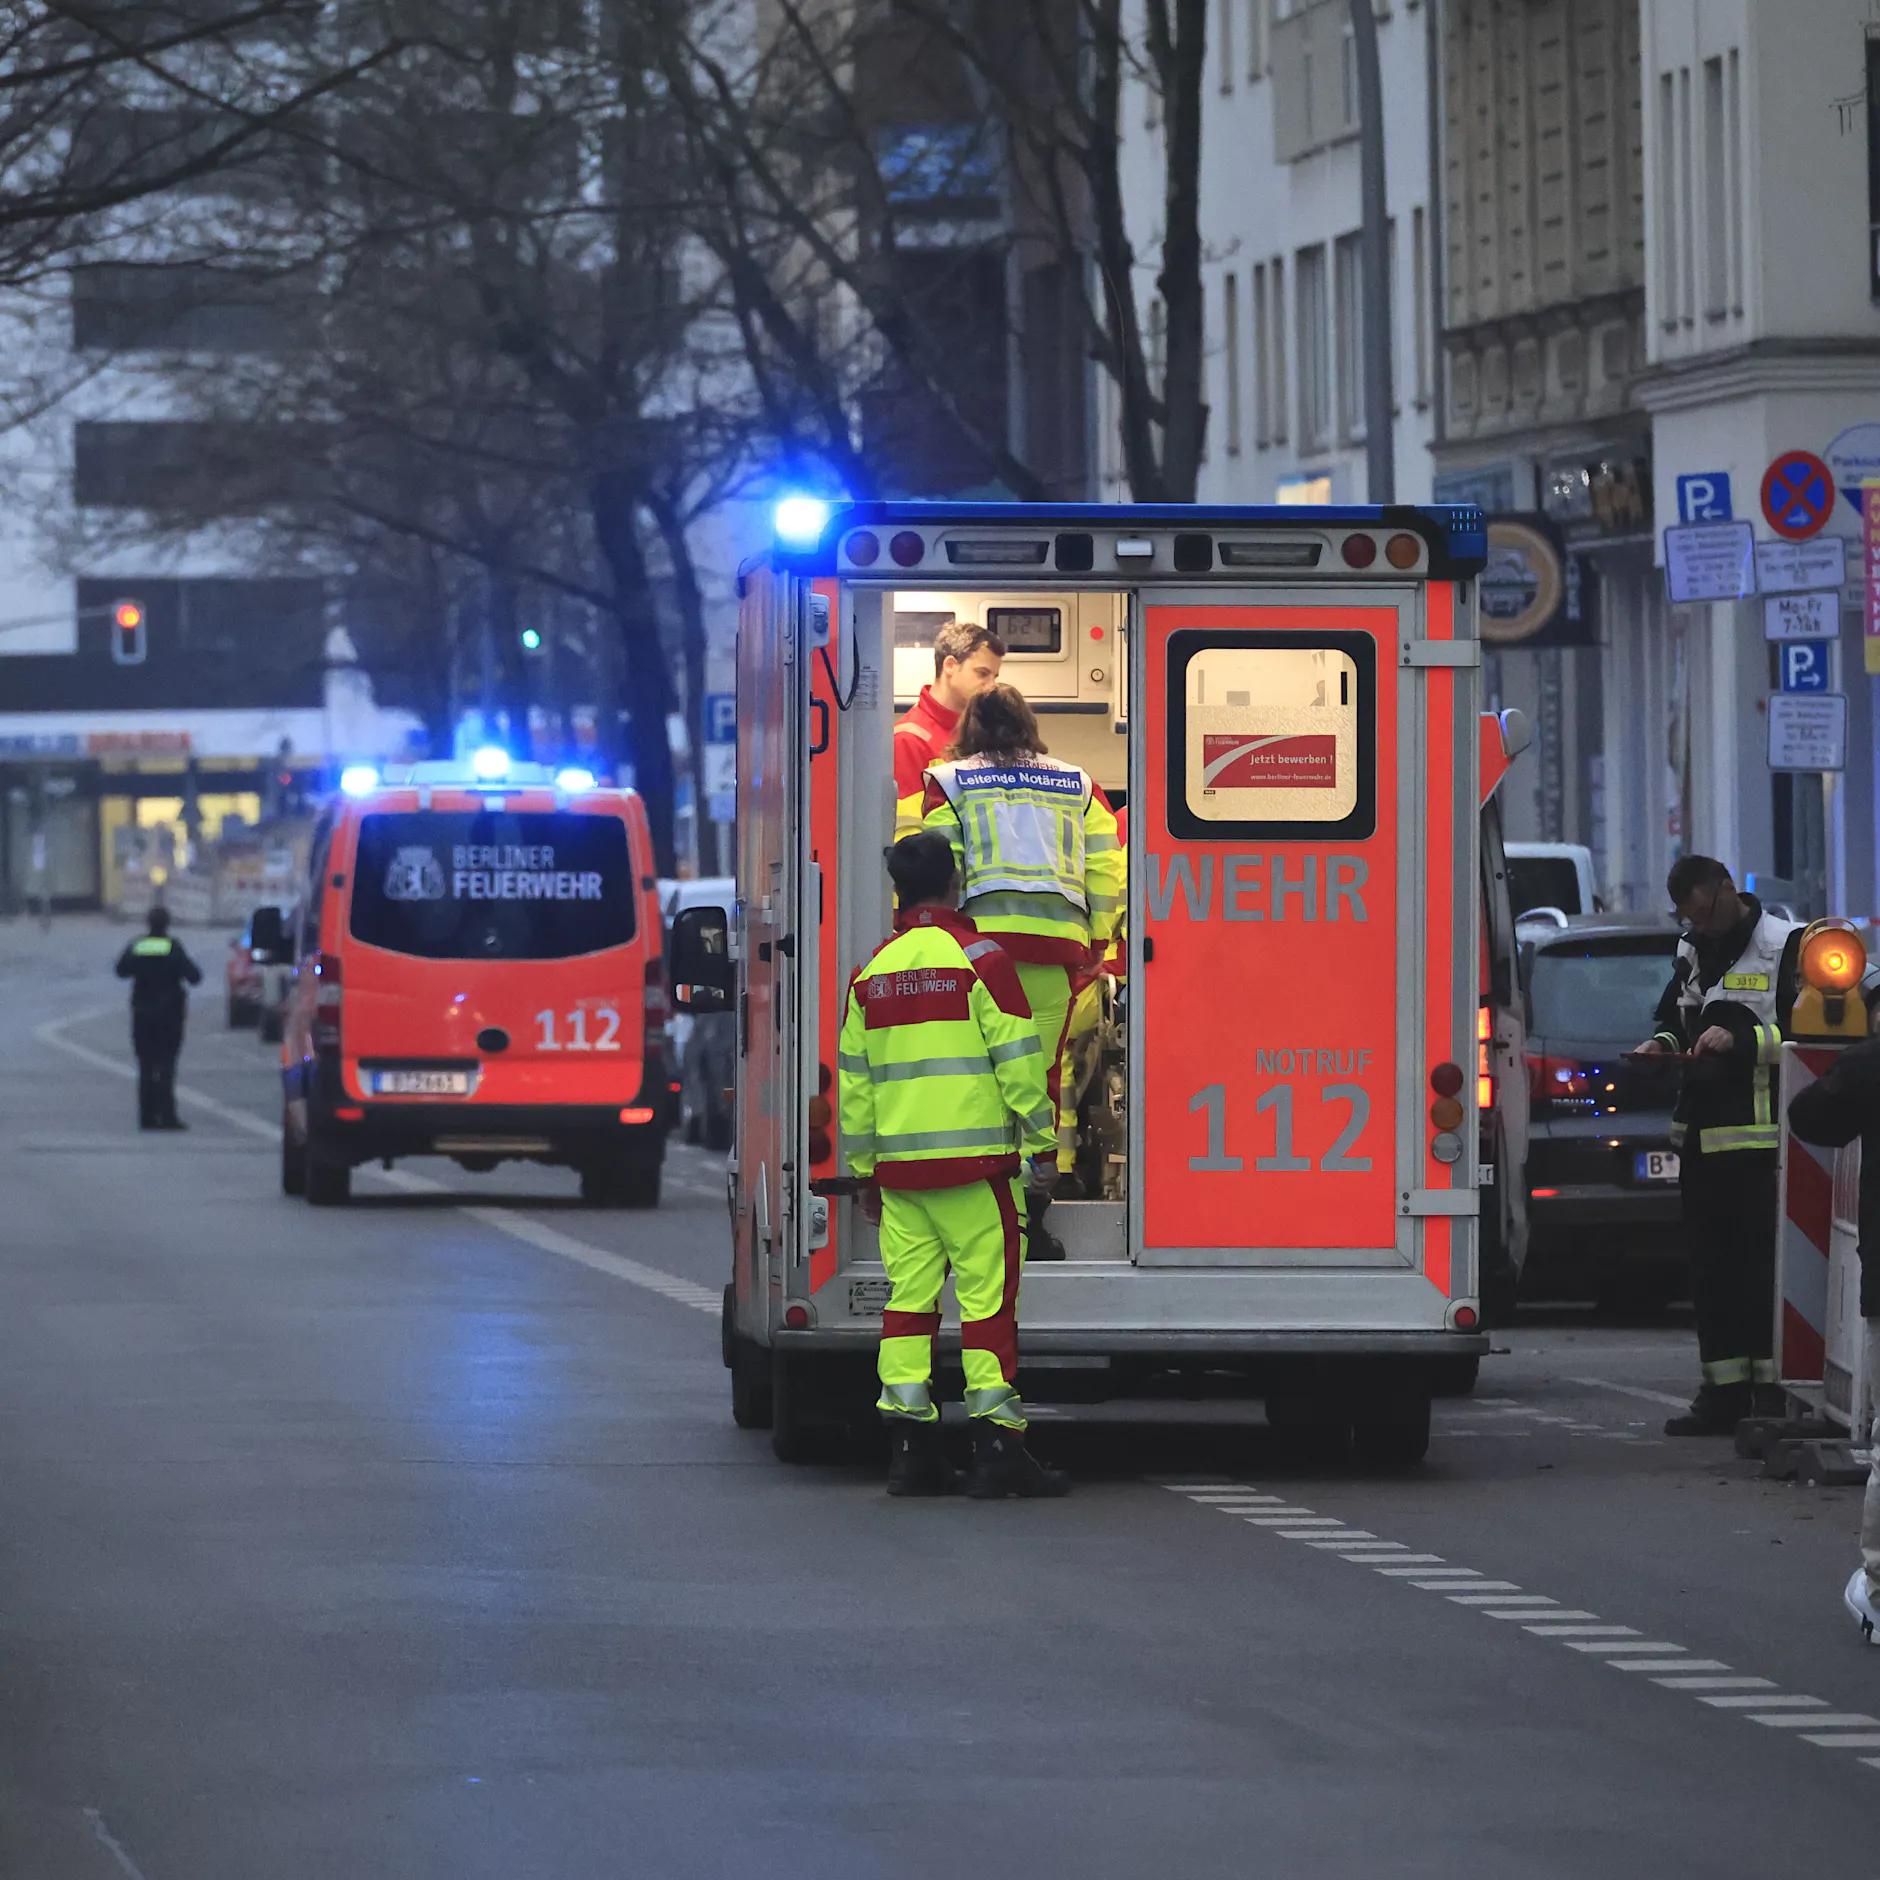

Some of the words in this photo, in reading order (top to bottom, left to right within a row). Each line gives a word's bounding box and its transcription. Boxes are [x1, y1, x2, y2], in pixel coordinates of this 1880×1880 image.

[1685, 480, 1715, 521] P
[1788, 644, 1814, 688] P
[713, 698, 736, 738] P
[1250, 754, 1275, 765] Jetzt
[1278, 754, 1326, 764] bewerben
[958, 772, 1016, 786] Leitende
[1019, 772, 1081, 789] Notärztin
[452, 845, 555, 869] BERLINER
[453, 871, 603, 900] FEUERWEHR
[1146, 854, 1369, 922] WEHR
[896, 969, 937, 983] BERLNER
[535, 1008, 621, 1051] 112
[1256, 1048, 1373, 1075] NOTRUF
[1188, 1083, 1373, 1172] 112
[1650, 1155, 1663, 1175] B
